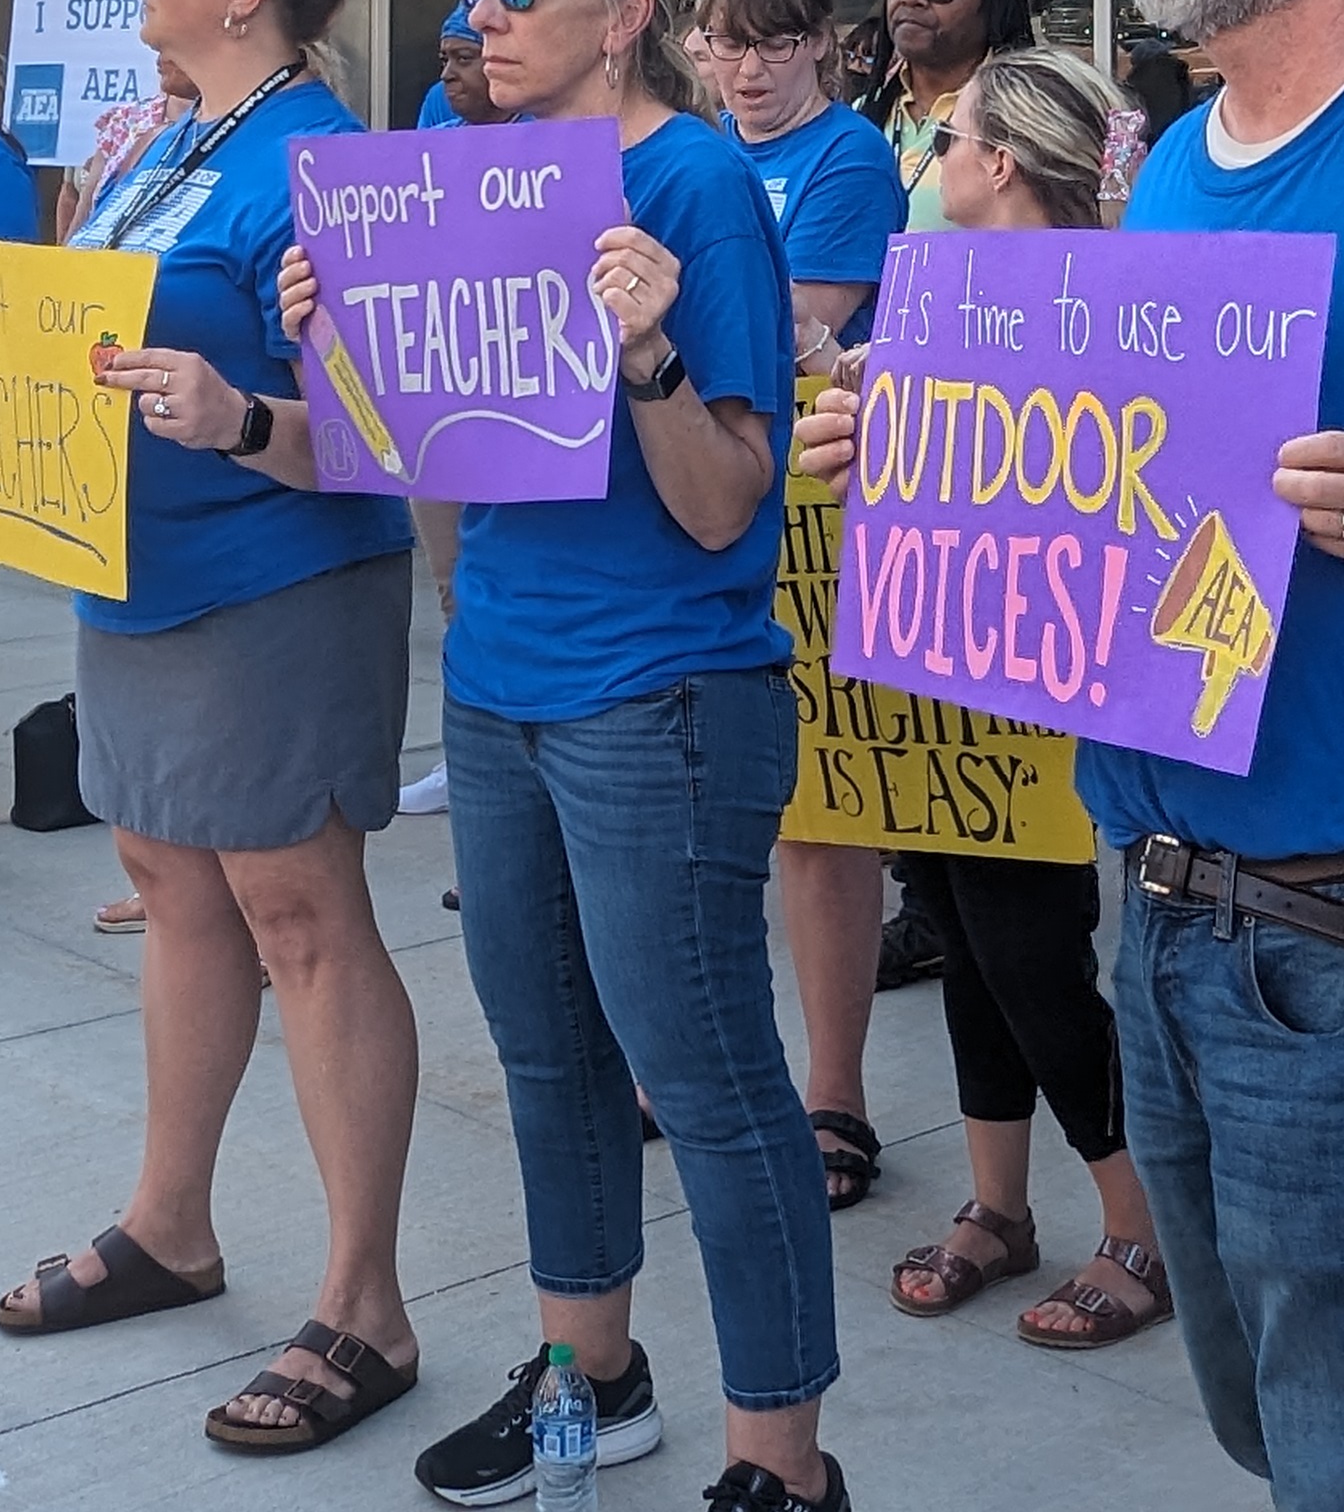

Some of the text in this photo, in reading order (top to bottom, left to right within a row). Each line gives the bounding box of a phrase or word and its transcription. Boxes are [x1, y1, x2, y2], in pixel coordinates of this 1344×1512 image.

[34, 1, 45, 33] I
[16, 94, 58, 121] AEA
[80, 67, 140, 102] AEA
[297, 148, 446, 259] Support
[480, 162, 562, 213] our
[38, 295, 105, 335] our
[343, 268, 615, 400] TEACHERS
[875, 242, 1317, 362] It's time to use our
[858, 370, 1181, 542] OUTDOOR
[855, 524, 1130, 707] VOICES!
[1192, 560, 1254, 658] AEA
[814, 747, 865, 817] IS
